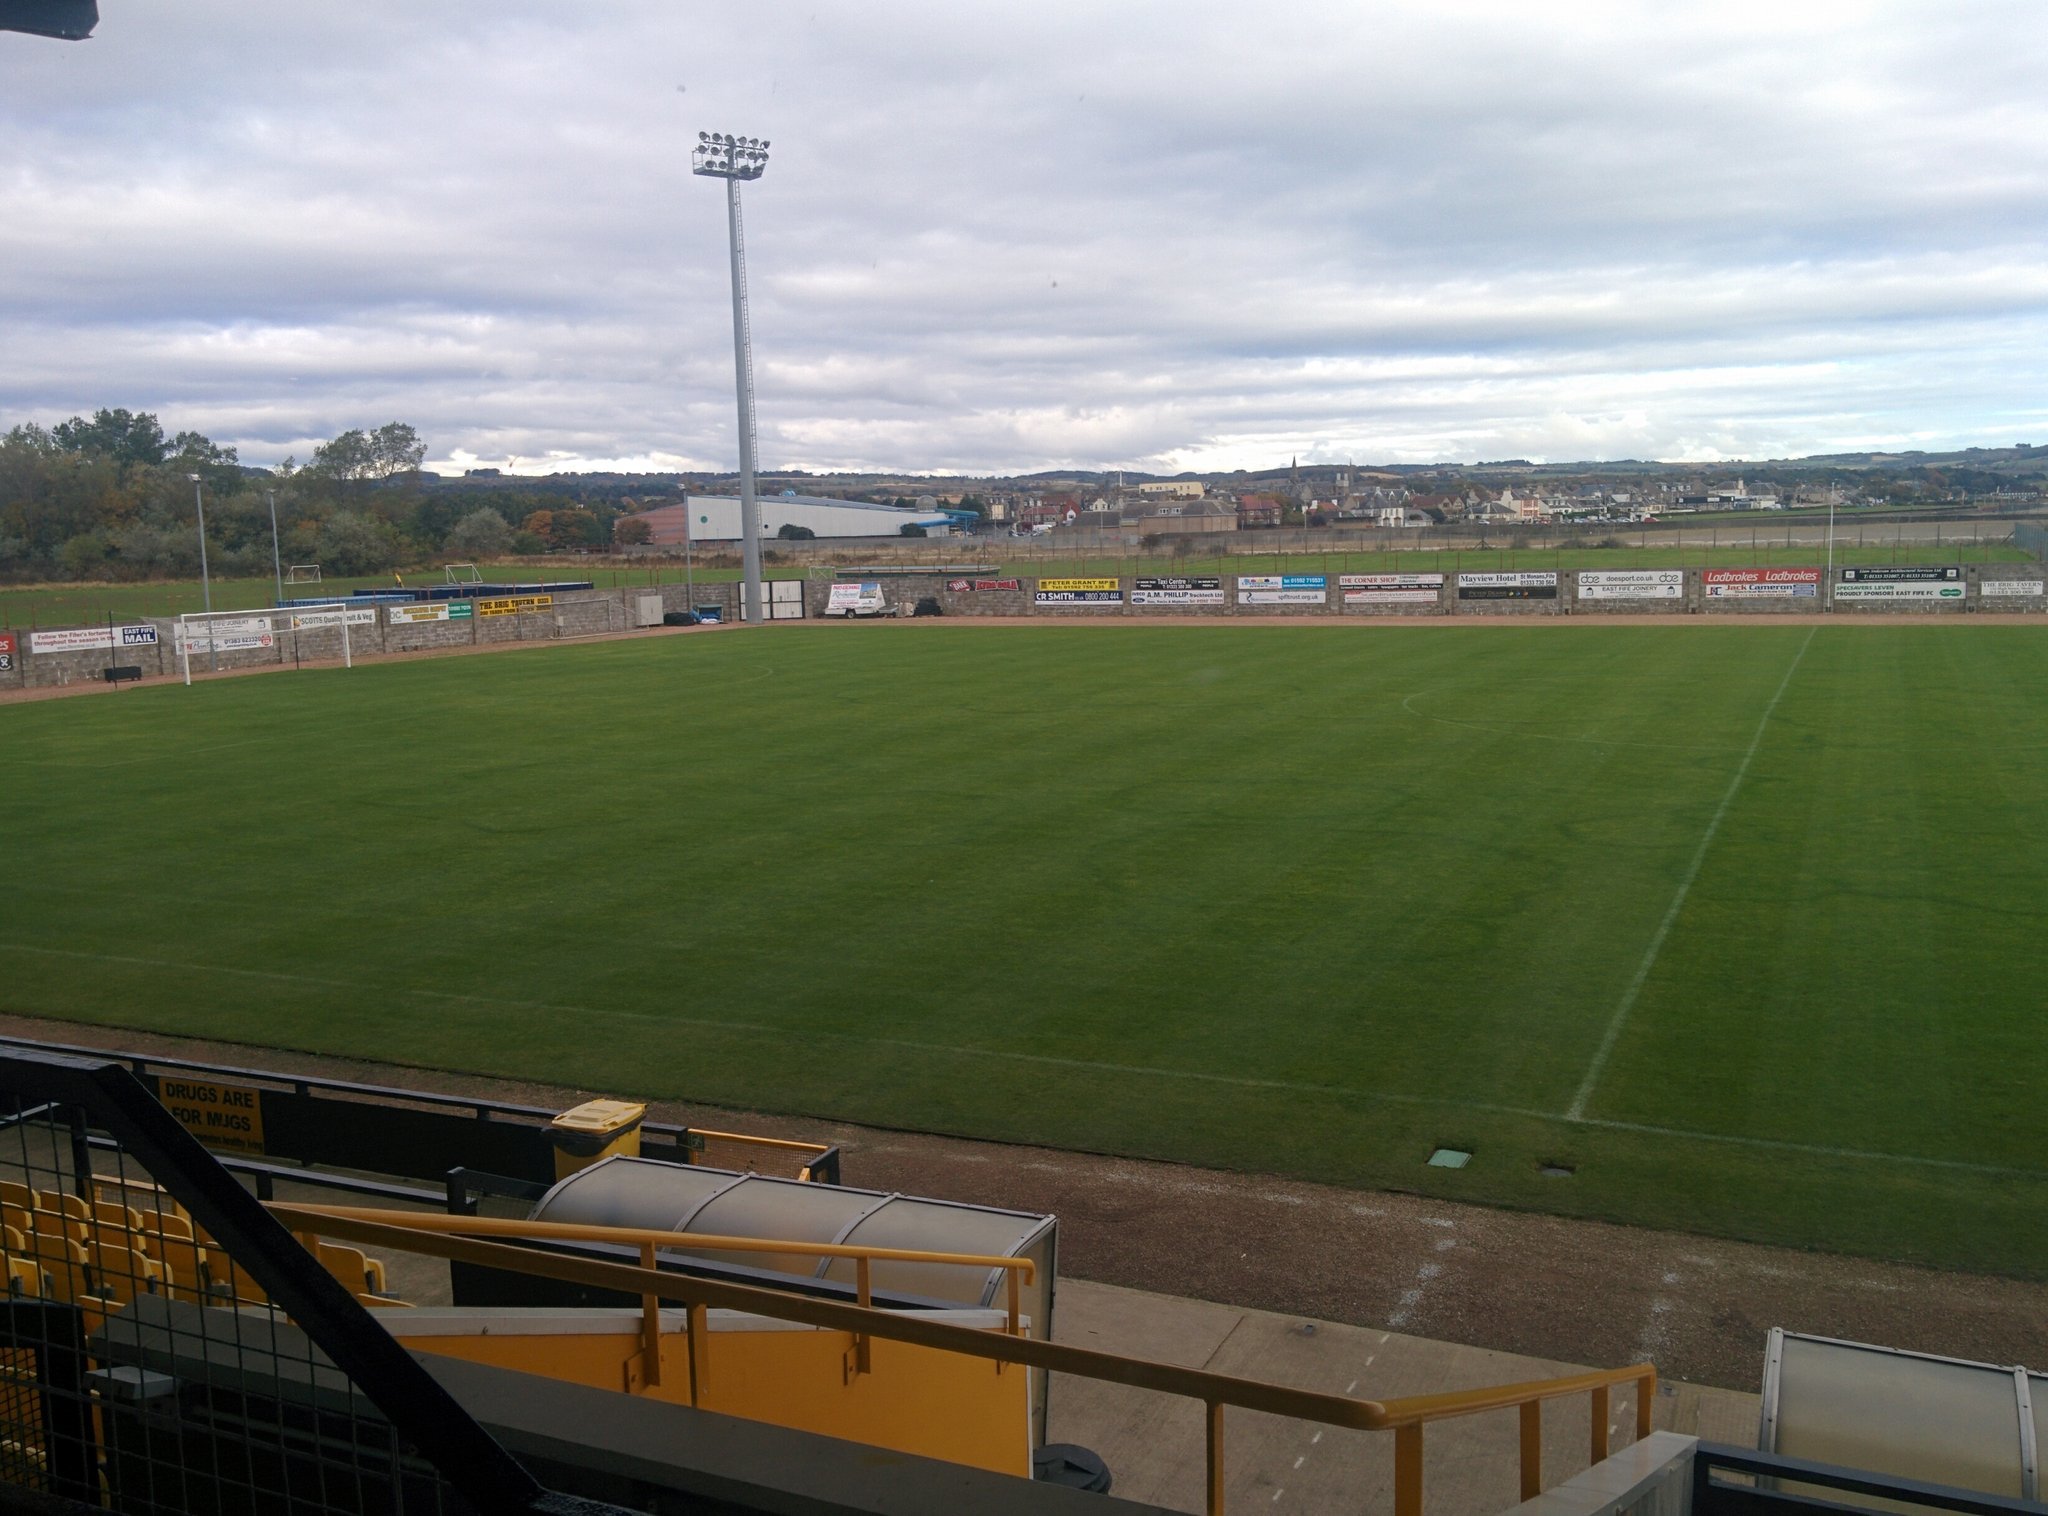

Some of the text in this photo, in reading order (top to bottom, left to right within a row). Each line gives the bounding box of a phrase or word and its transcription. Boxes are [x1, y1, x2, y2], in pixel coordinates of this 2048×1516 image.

[1461, 575, 1493, 584] Mayview
[1708, 571, 1817, 582] Ladbrokes Ladbrokes
[1048, 592, 1075, 600] SMITH
[1110, 592, 1119, 600] 444
[480, 602, 493, 610] THE
[511, 599, 535, 607] TAVERN
[301, 616, 322, 625] SCOTTS
[324, 615, 343, 624] Quality
[362, 613, 372, 621] Veg
[34, 640, 67, 648] throughout
[125, 633, 154, 644] MAIL
[165, 1082, 254, 1108] DRUGS ARE
[171, 1106, 251, 1131] FOR MUGS
